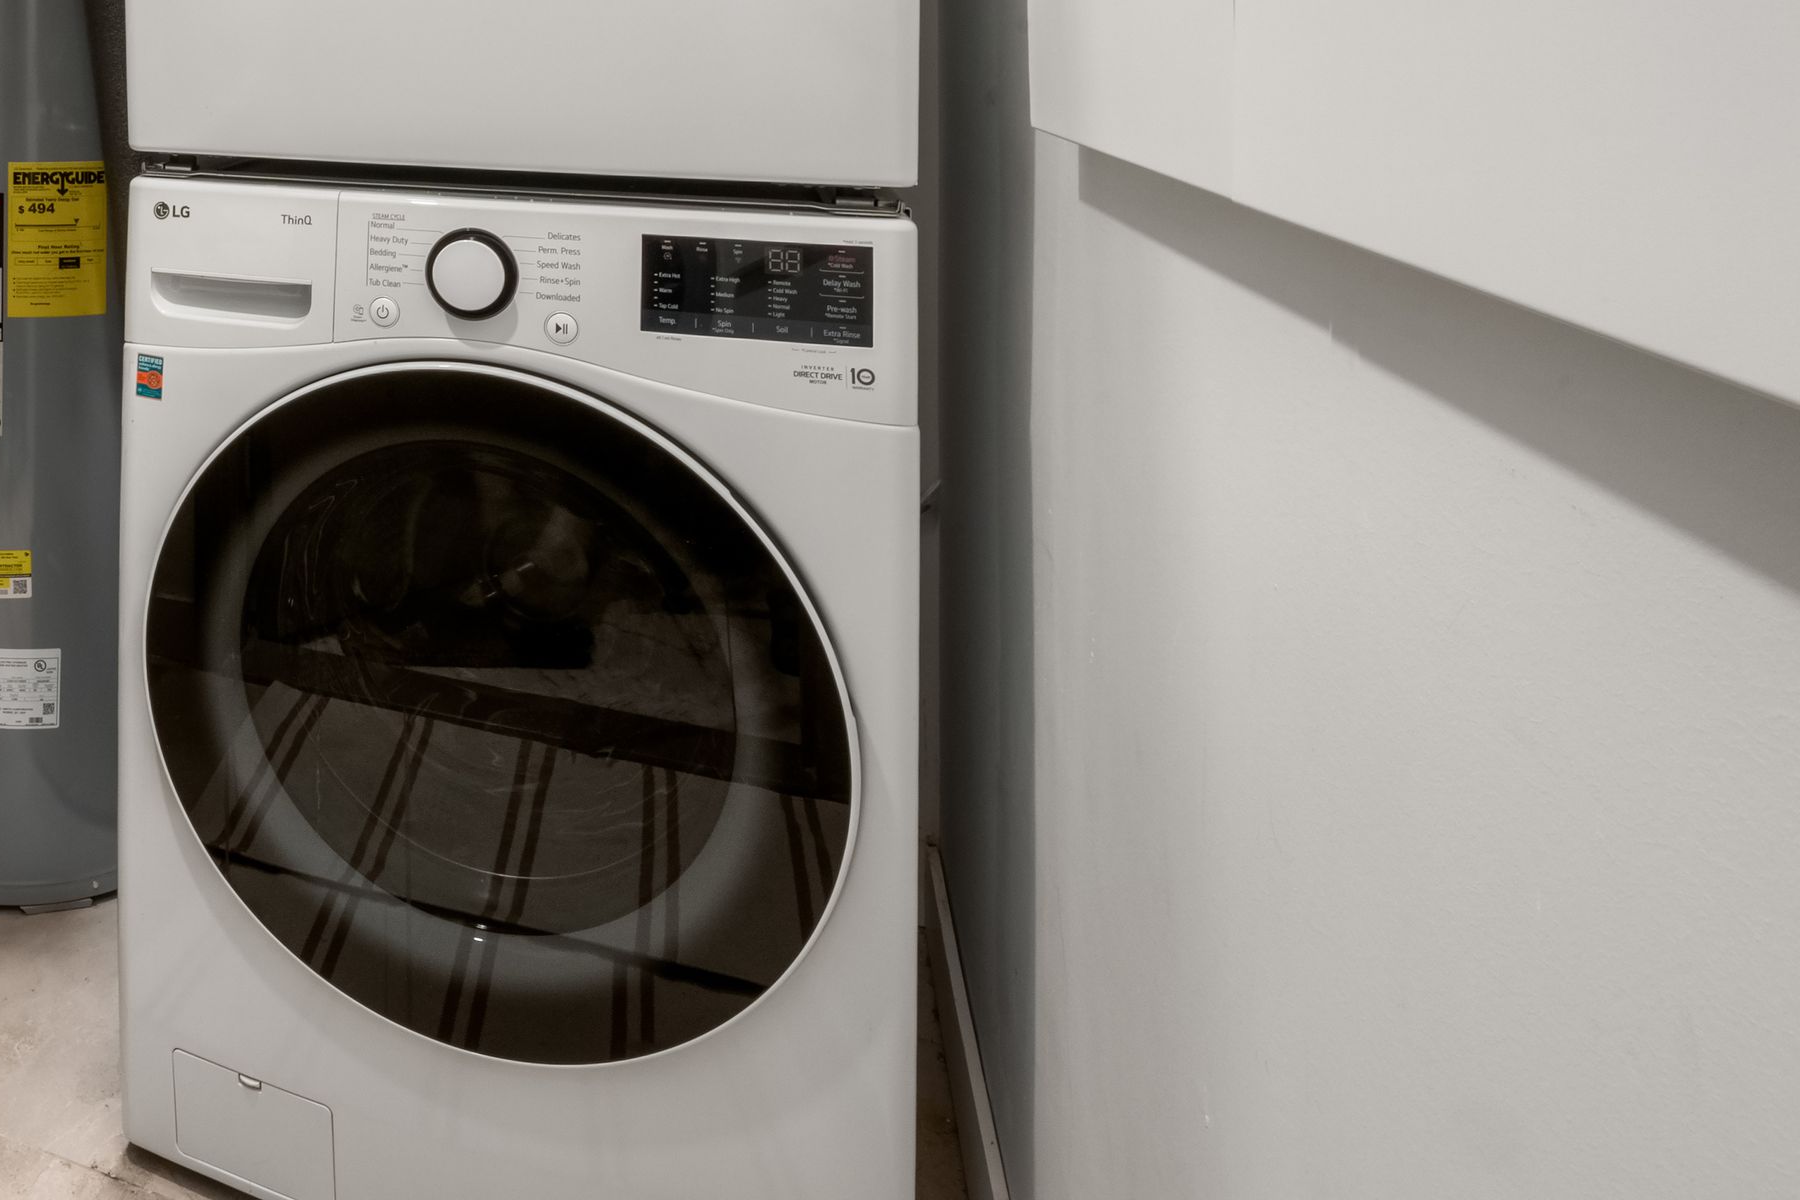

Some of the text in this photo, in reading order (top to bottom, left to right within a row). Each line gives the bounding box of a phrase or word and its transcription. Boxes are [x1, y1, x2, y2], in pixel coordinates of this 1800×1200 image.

[28, 202, 55, 214] 494
[172, 204, 191, 218] LG
[280, 213, 313, 226] ThinQ
[370, 220, 395, 230] Normal
[370, 234, 409, 246] Heavy Duty
[547, 231, 582, 242] Delicates
[369, 247, 397, 258] Bedding
[537, 245, 581, 256] Perm. Press
[536, 260, 581, 271] Speed Wash
[369, 278, 401, 288] Tub Clean
[822, 278, 861, 288] Delay Wash
[535, 291, 581, 303] Downloaded
[826, 304, 857, 314] Pre-wash
[717, 320, 732, 329] Spin
[775, 325, 789, 334] Soil
[823, 329, 861, 339] Extra Rinse
[800, 364, 834, 372] INVERTER
[793, 370, 843, 381] DIRECT DRIVE
[850, 367, 876, 386] 10
